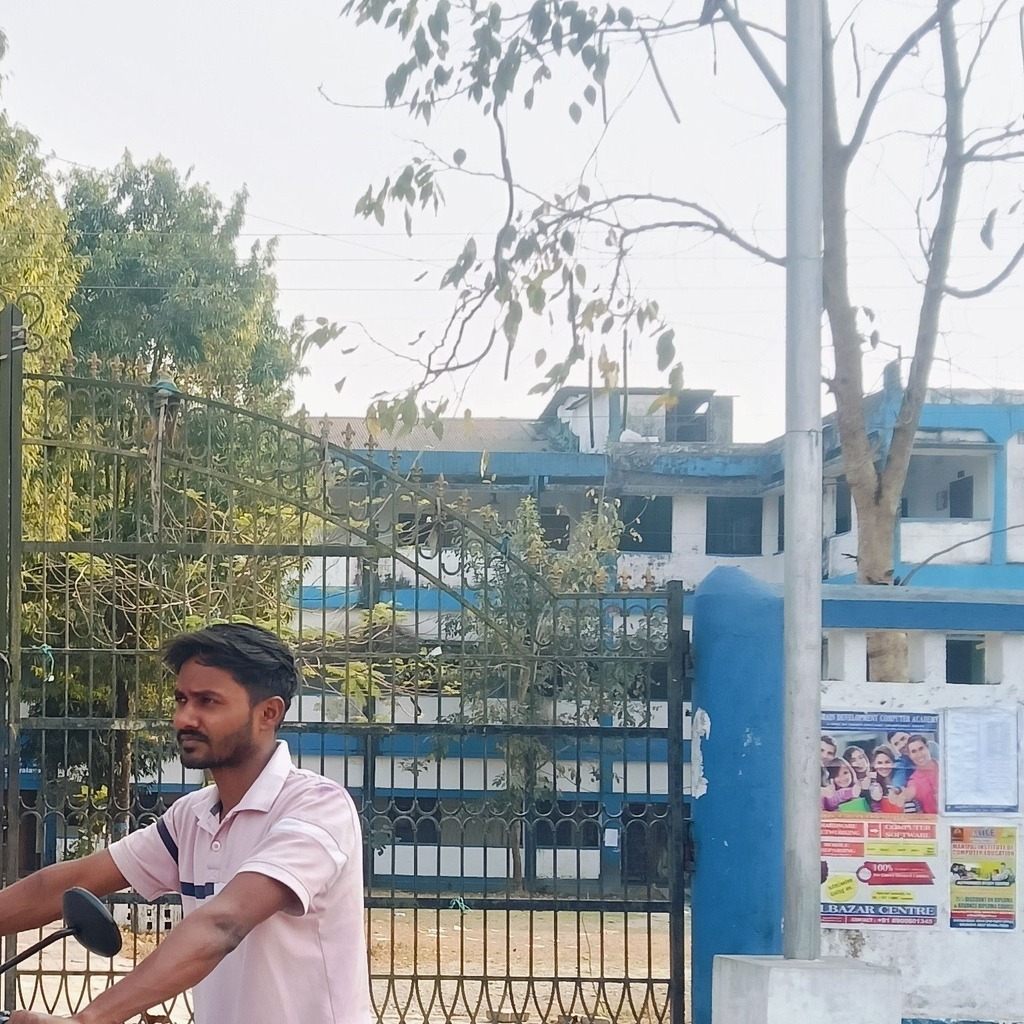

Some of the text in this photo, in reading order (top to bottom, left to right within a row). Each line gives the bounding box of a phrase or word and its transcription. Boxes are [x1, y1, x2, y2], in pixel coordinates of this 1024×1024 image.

[837, 713, 878, 722] DEVELOPMENT
[912, 716, 938, 724] ACADEMY
[873, 863, 893, 872] 100%
[821, 904, 934, 916] LBAZAR CENTRE
